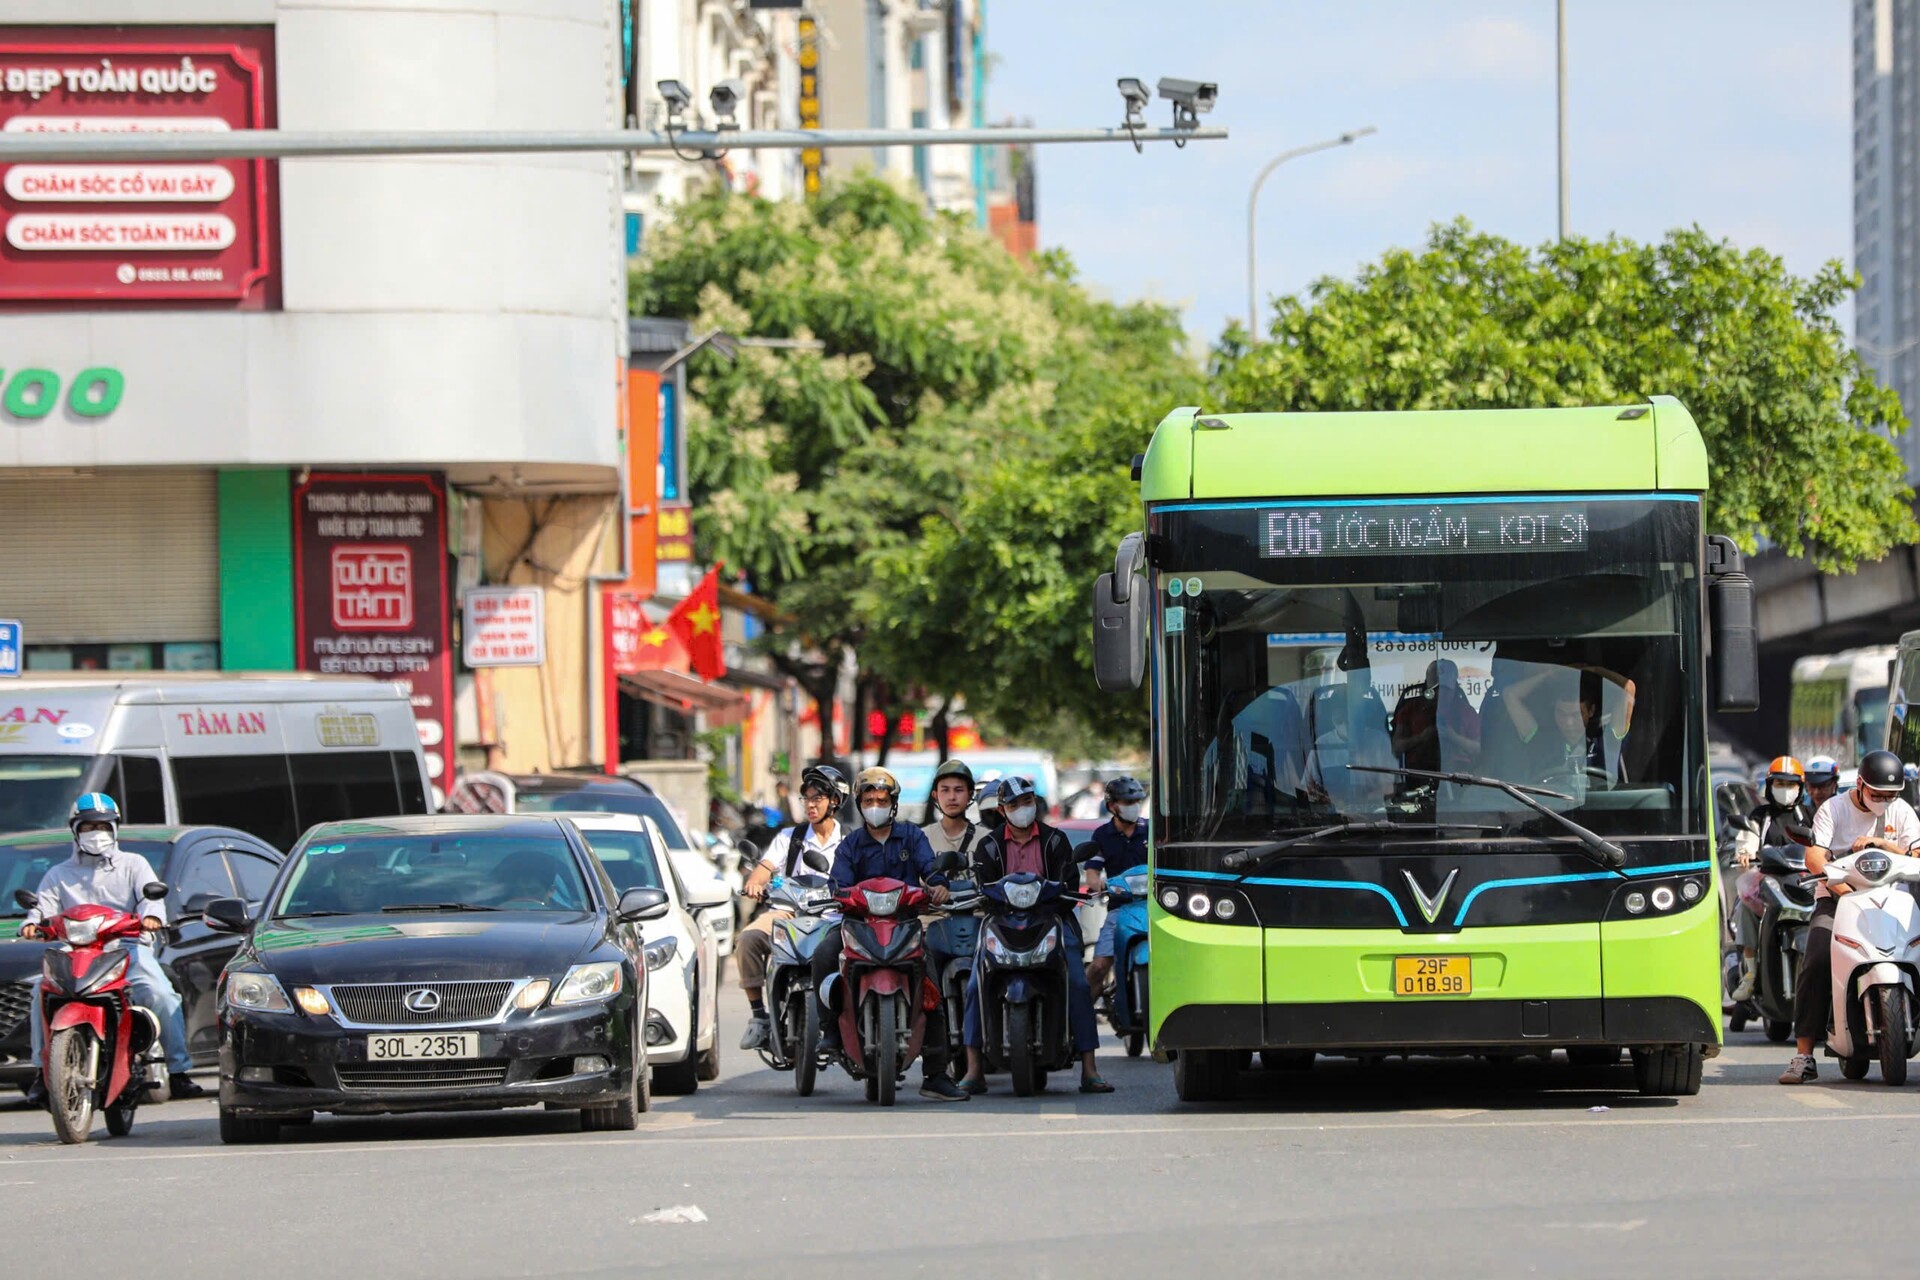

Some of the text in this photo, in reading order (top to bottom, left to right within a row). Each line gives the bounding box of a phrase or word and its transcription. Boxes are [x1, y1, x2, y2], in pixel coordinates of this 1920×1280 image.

[6, 69, 62, 99] ĐẸP
[63, 58, 138, 92] TOÀN
[140, 56, 217, 94] QUỐC
[22, 173, 76, 193] CHĂM
[79, 174, 115, 193] SÓC
[147, 178, 177, 193] VAI
[180, 175, 216, 193] GÁY
[22, 222, 220, 243] CHĂM SÓC TOÀN THÂN
[1268, 512, 1322, 556] E06
[1389, 506, 1467, 548] NGẦM
[1501, 515, 1549, 545] KĐT
[237, 711, 266, 734] AN
[1417, 959, 1448, 975] 29F
[1404, 976, 1463, 992] 018.98
[374, 1036, 466, 1058] 30L-2351
